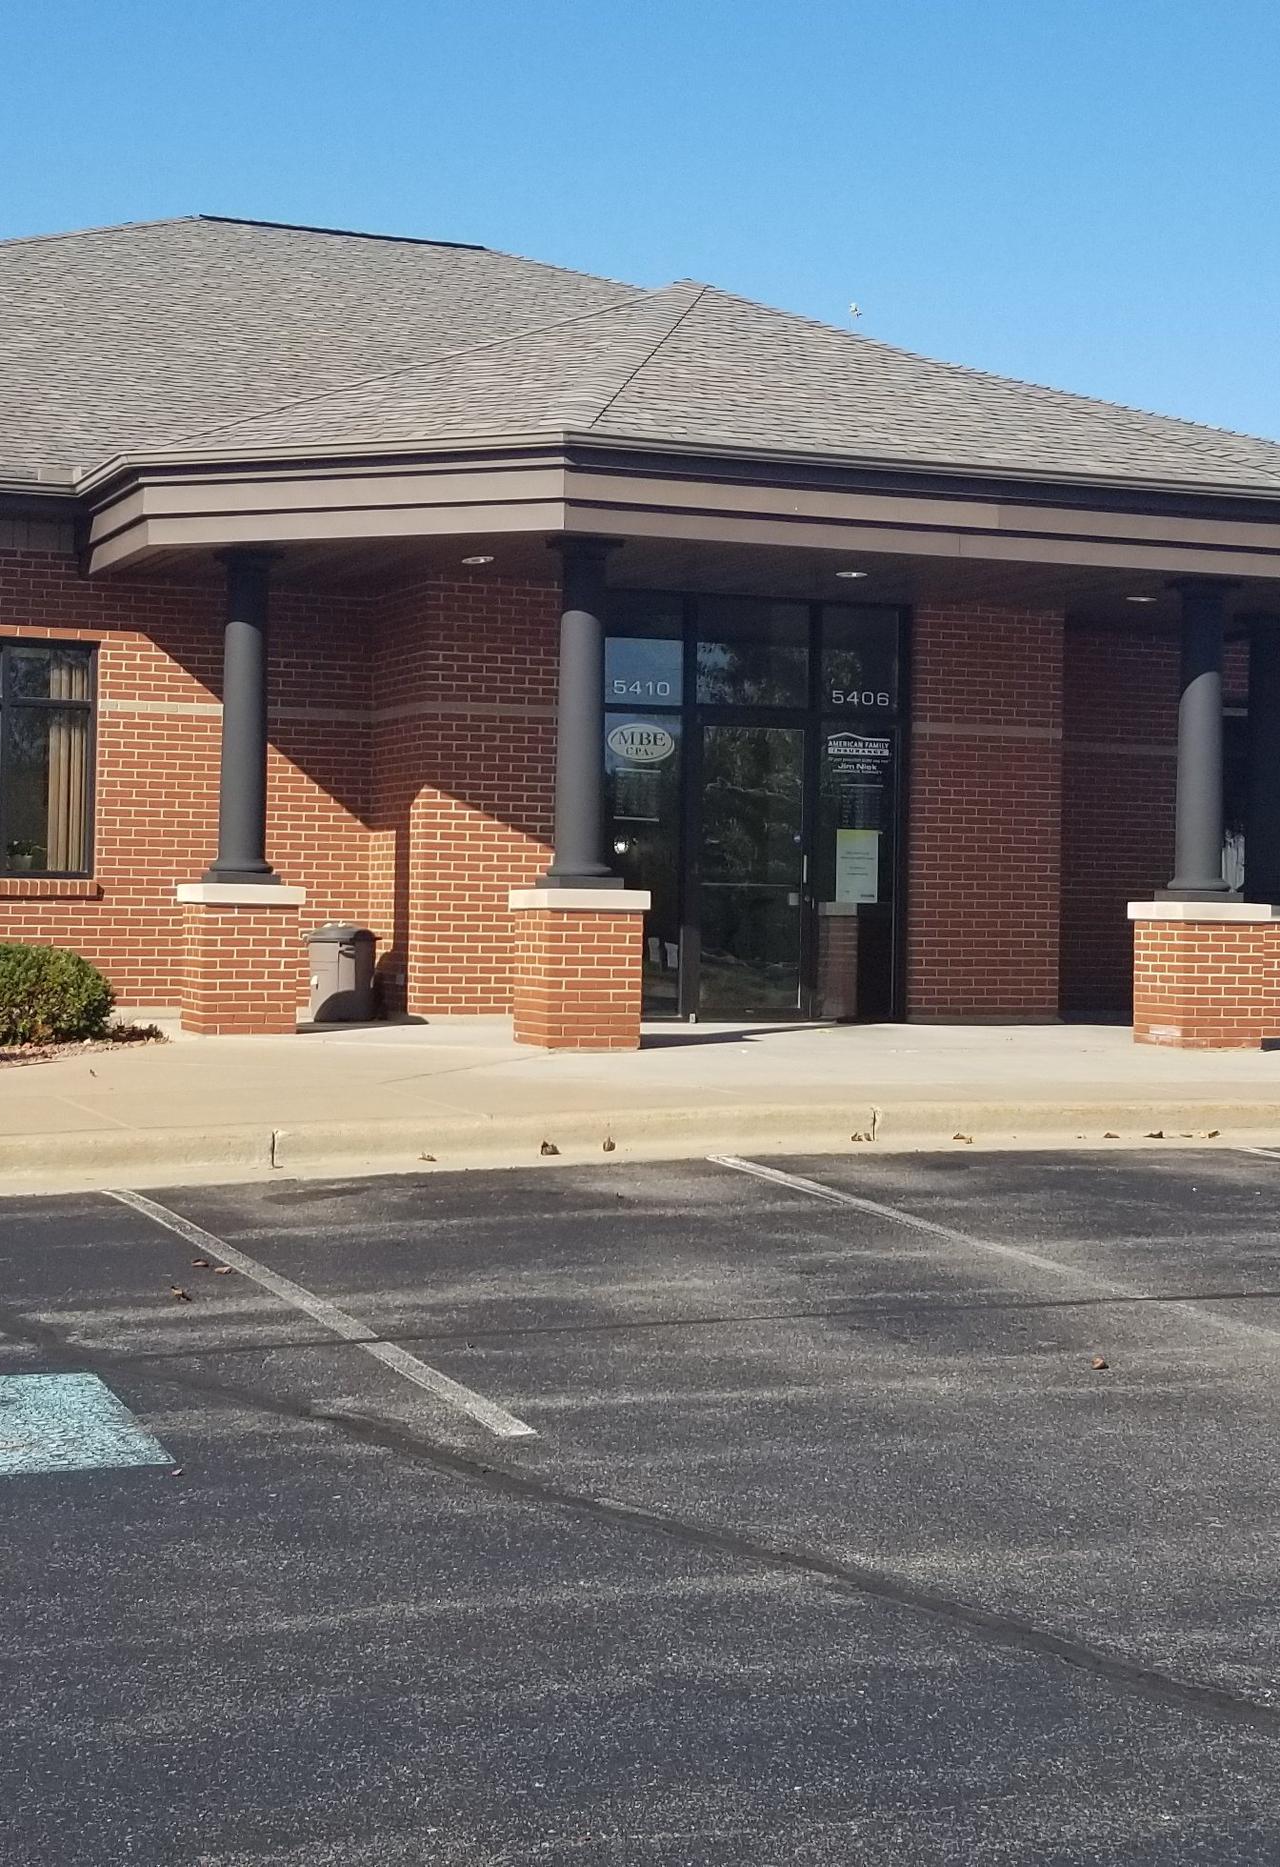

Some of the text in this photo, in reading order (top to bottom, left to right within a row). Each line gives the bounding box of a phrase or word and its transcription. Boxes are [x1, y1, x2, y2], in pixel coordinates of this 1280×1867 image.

[613, 680, 670, 696] 5410
[831, 690, 890, 707] 5406
[618, 731, 666, 747] MBE
[828, 740, 863, 748] AMERICAN
